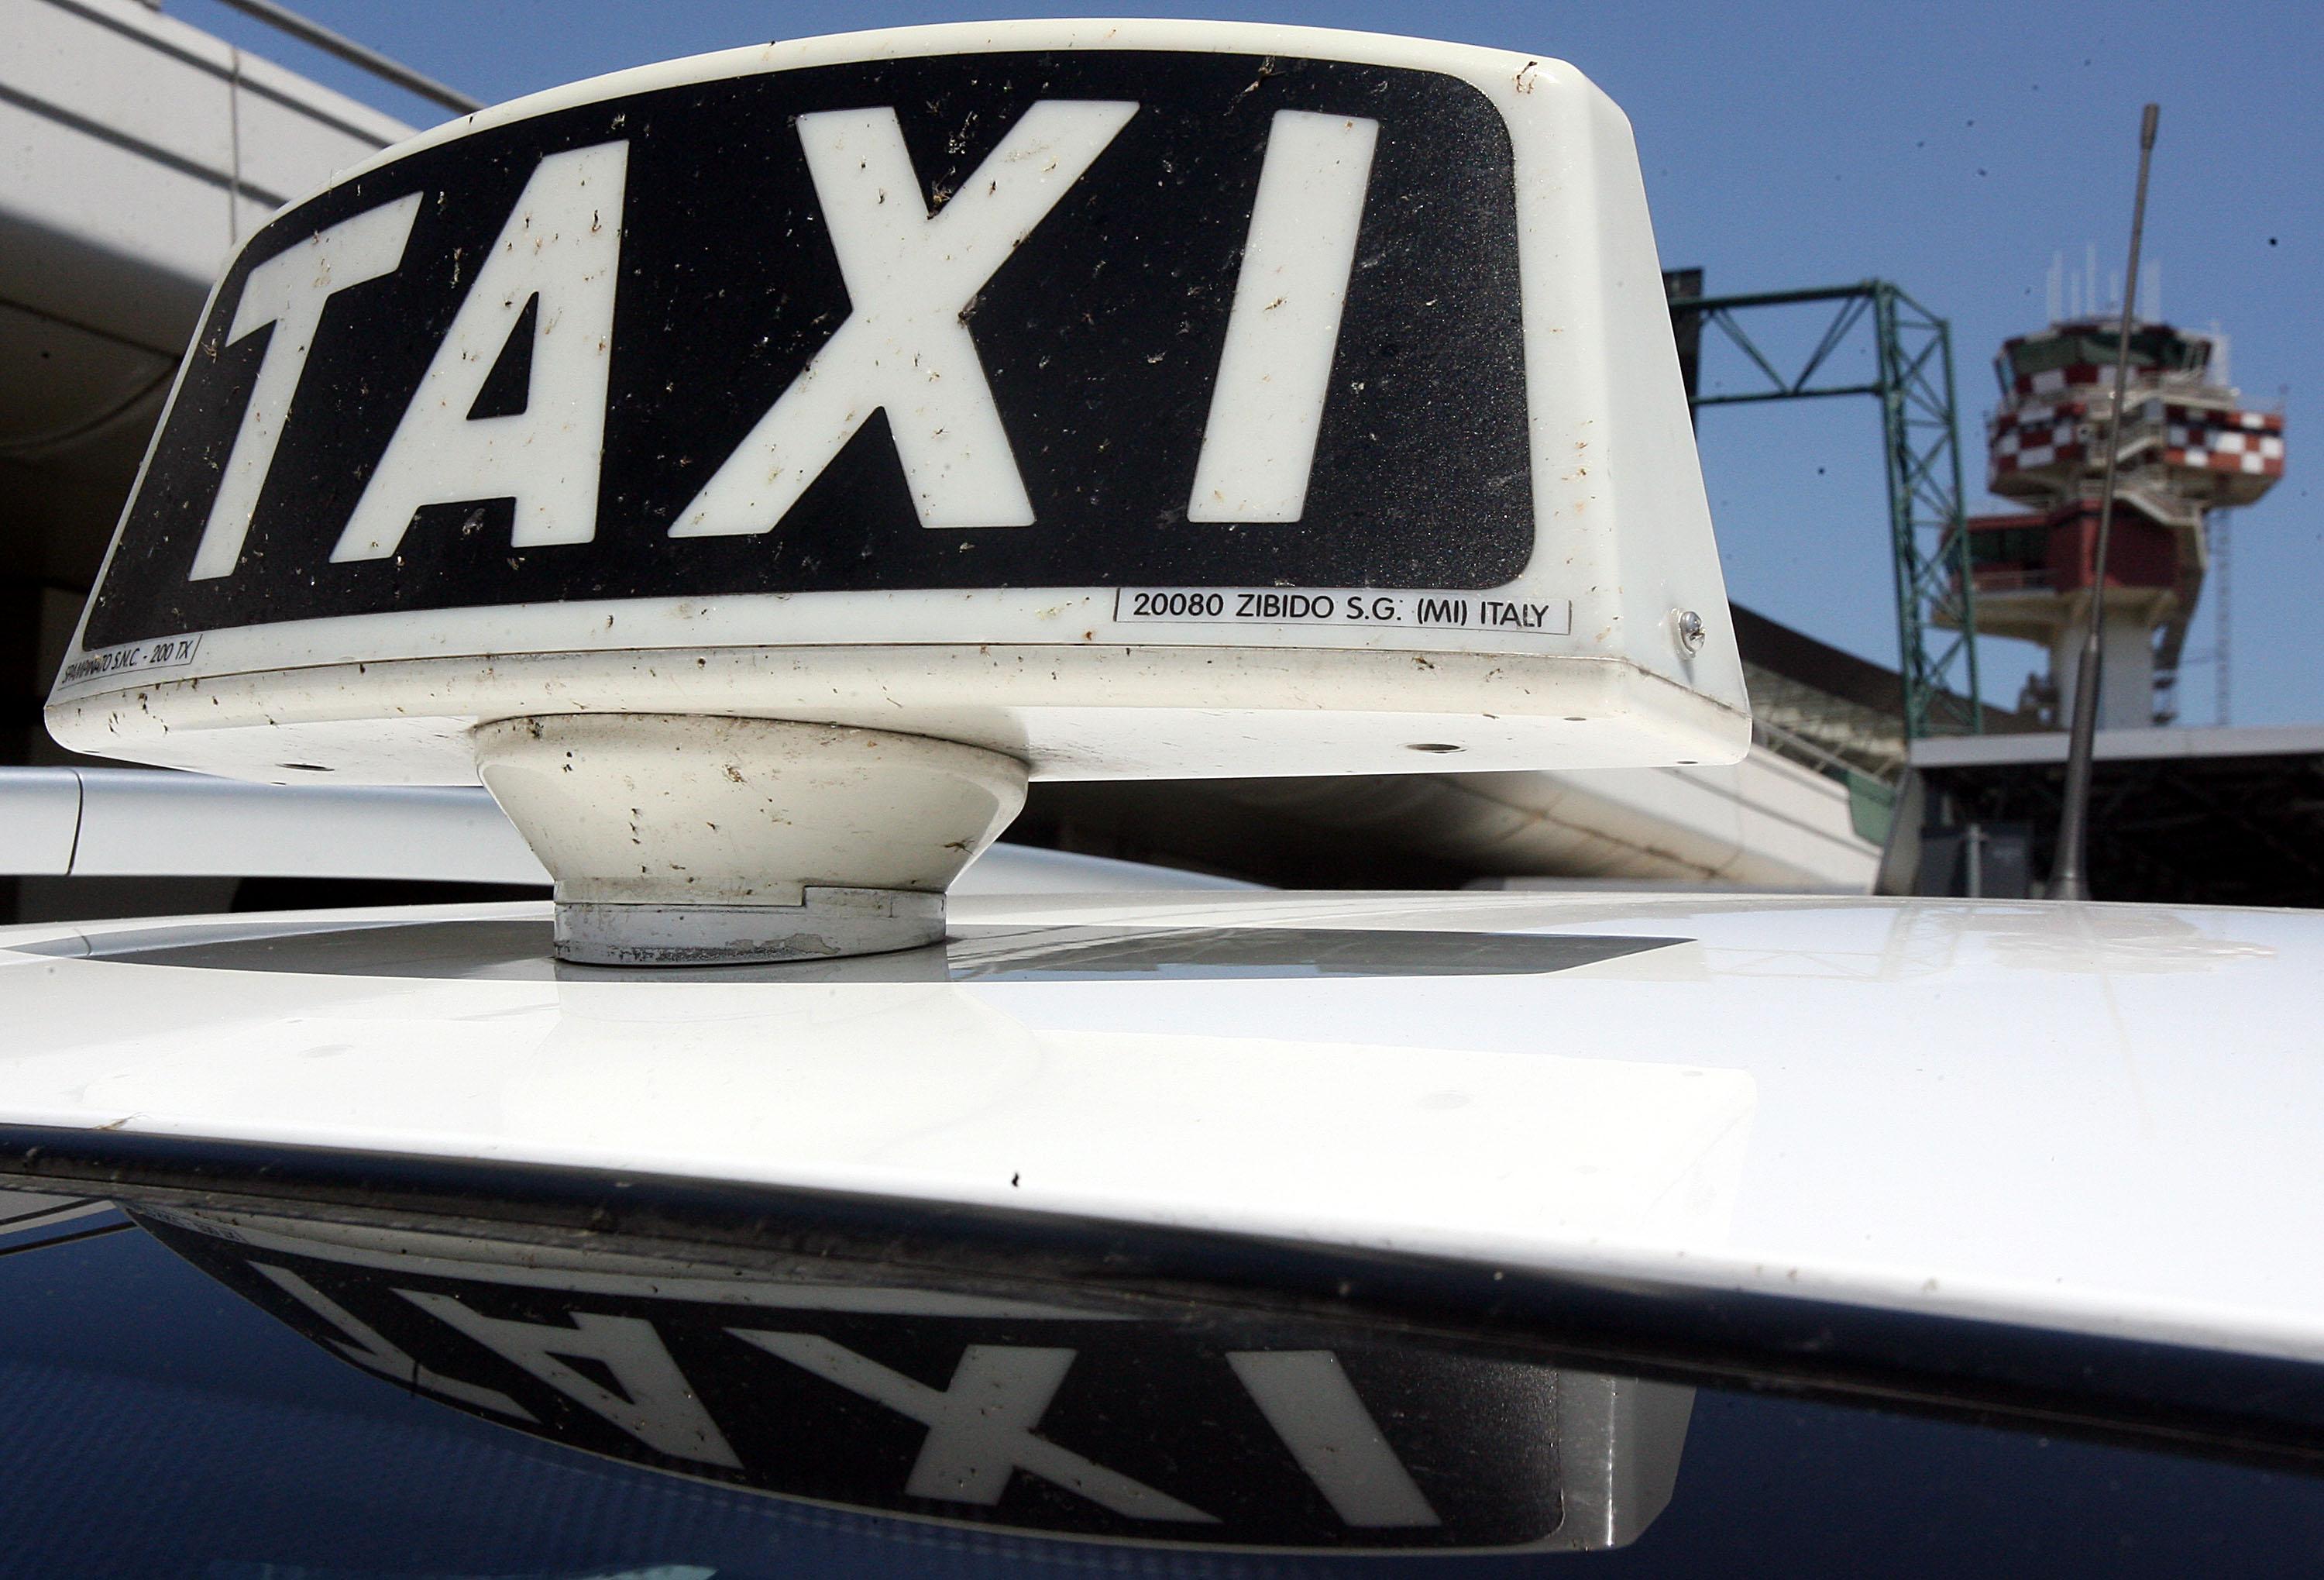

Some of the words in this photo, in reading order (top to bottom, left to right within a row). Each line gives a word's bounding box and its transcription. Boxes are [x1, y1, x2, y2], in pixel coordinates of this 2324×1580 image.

[190, 100, 1379, 582] TAXI
[1133, 593, 1224, 616] 20080
[1236, 594, 1335, 619] ZIBIDO
[1346, 596, 1401, 621] S.G.
[1417, 597, 1467, 626] (MI)
[1480, 601, 1549, 628] ITALY
[150, 642, 174, 663] 200
[175, 640, 194, 660] TX
